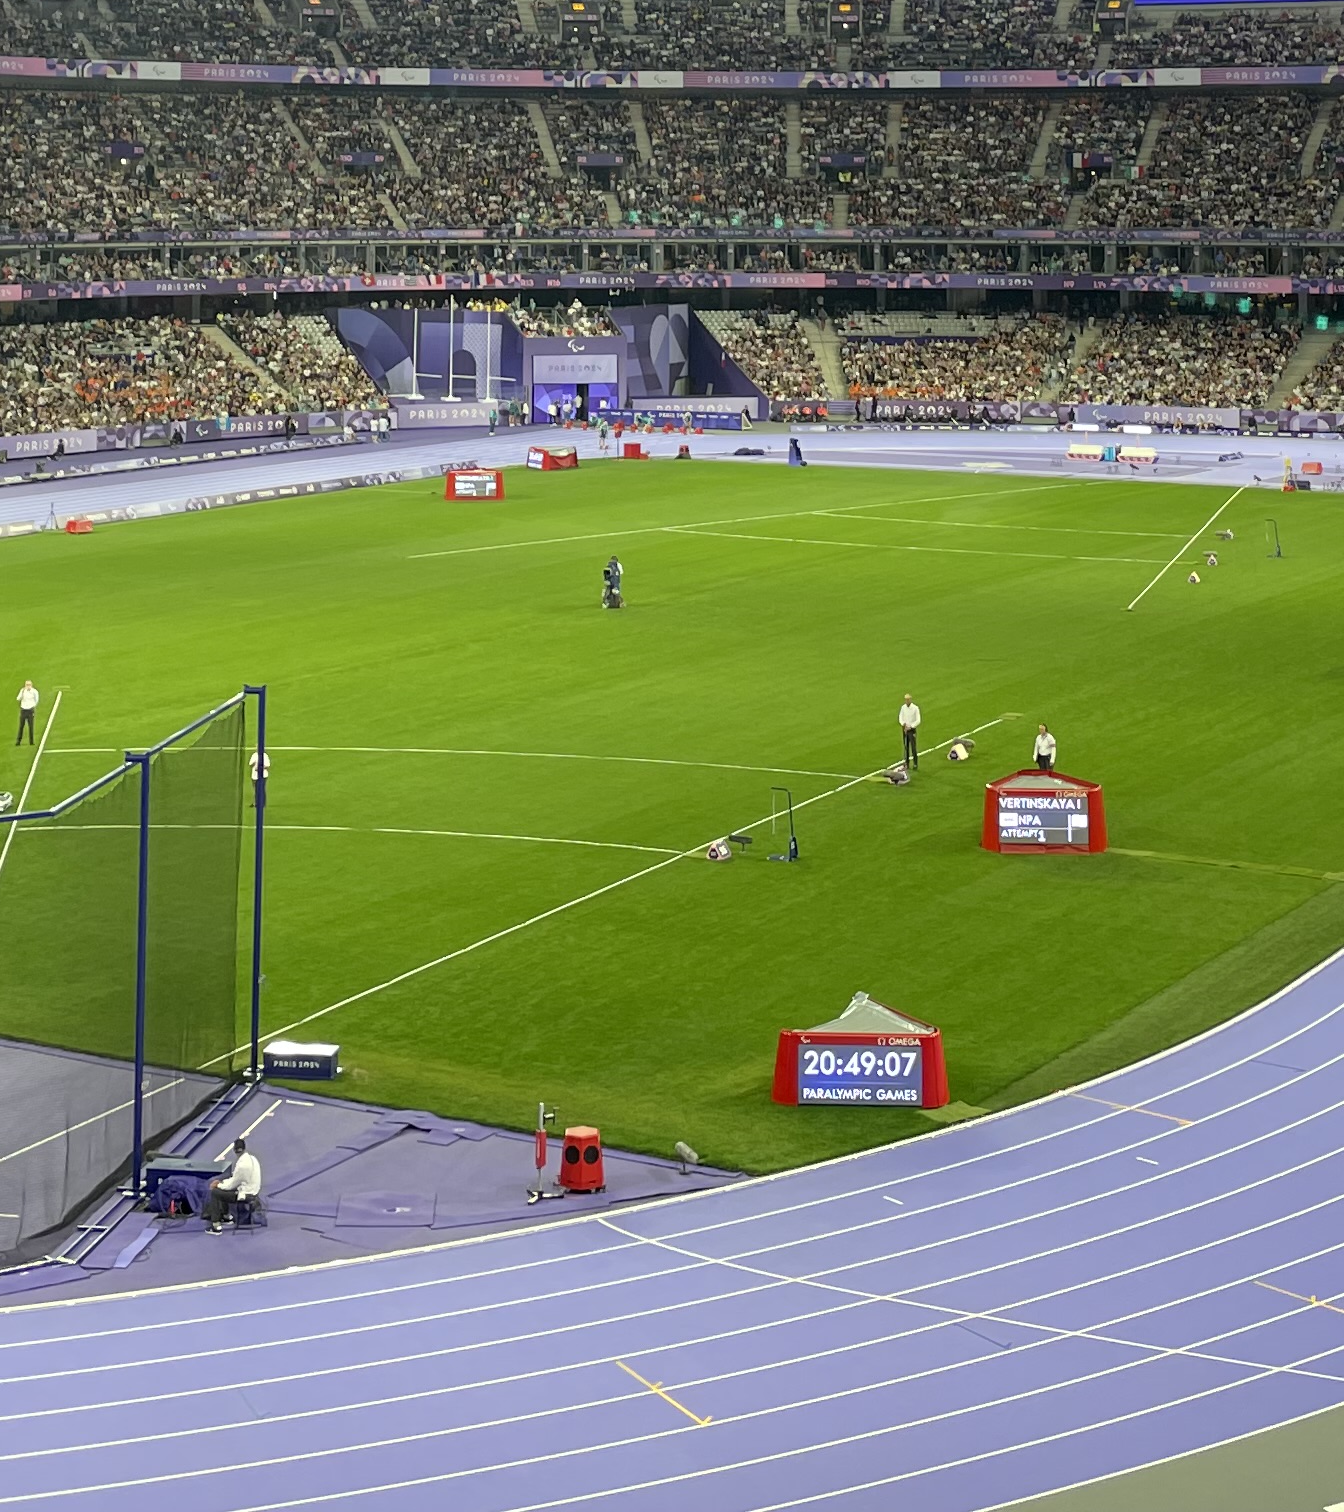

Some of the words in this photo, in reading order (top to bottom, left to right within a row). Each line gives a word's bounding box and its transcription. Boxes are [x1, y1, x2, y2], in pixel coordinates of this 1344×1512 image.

[204, 67, 237, 78] PARIS
[240, 68, 269, 78] 2024
[453, 72, 486, 83] PARIS
[490, 73, 520, 83] 2024
[1225, 71, 1260, 81] PARIS
[1264, 71, 1296, 81] 2024
[707, 74, 740, 84] PARIS
[743, 74, 775, 84] 2024
[964, 74, 997, 84] PARIS
[1001, 74, 1033, 84] 2024
[579, 277, 606, 285] PARIS
[609, 277, 635, 285] 2024
[749, 276, 777, 285] PARIS
[780, 276, 806, 285] 2024
[977, 278, 1006, 286] PARIS
[1008, 278, 1034, 286] 2024
[1210, 281, 1239, 289] PARIS
[1242, 281, 1269, 289] 2024
[156, 283, 181, 291] PARIS
[183, 283, 207, 291] 2024
[548, 364, 575, 372] PARIS
[409, 409, 447, 419] PARIS
[452, 407, 486, 418] 2024
[918, 405, 952, 415] 2024
[1144, 411, 1182, 422] PARIS
[1187, 413, 1223, 423] 2024
[230, 420, 264, 432] PARIS
[267, 419, 299, 431] 204
[16, 440, 49, 452] PARIS
[999, 797, 1075, 809] VERTINSKAYA
[1018, 814, 1042, 826] NPA
[1001, 830, 1038, 838] ATTEMPT
[888, 1037, 921, 1046] OMEGA
[273, 1060, 297, 1068] PARIS
[298, 1060, 320, 1069] 2024
[804, 1050, 917, 1077] 20:49:07
[802, 1087, 872, 1100] PARALYMPIC
[876, 1088, 918, 1101] GAMES
